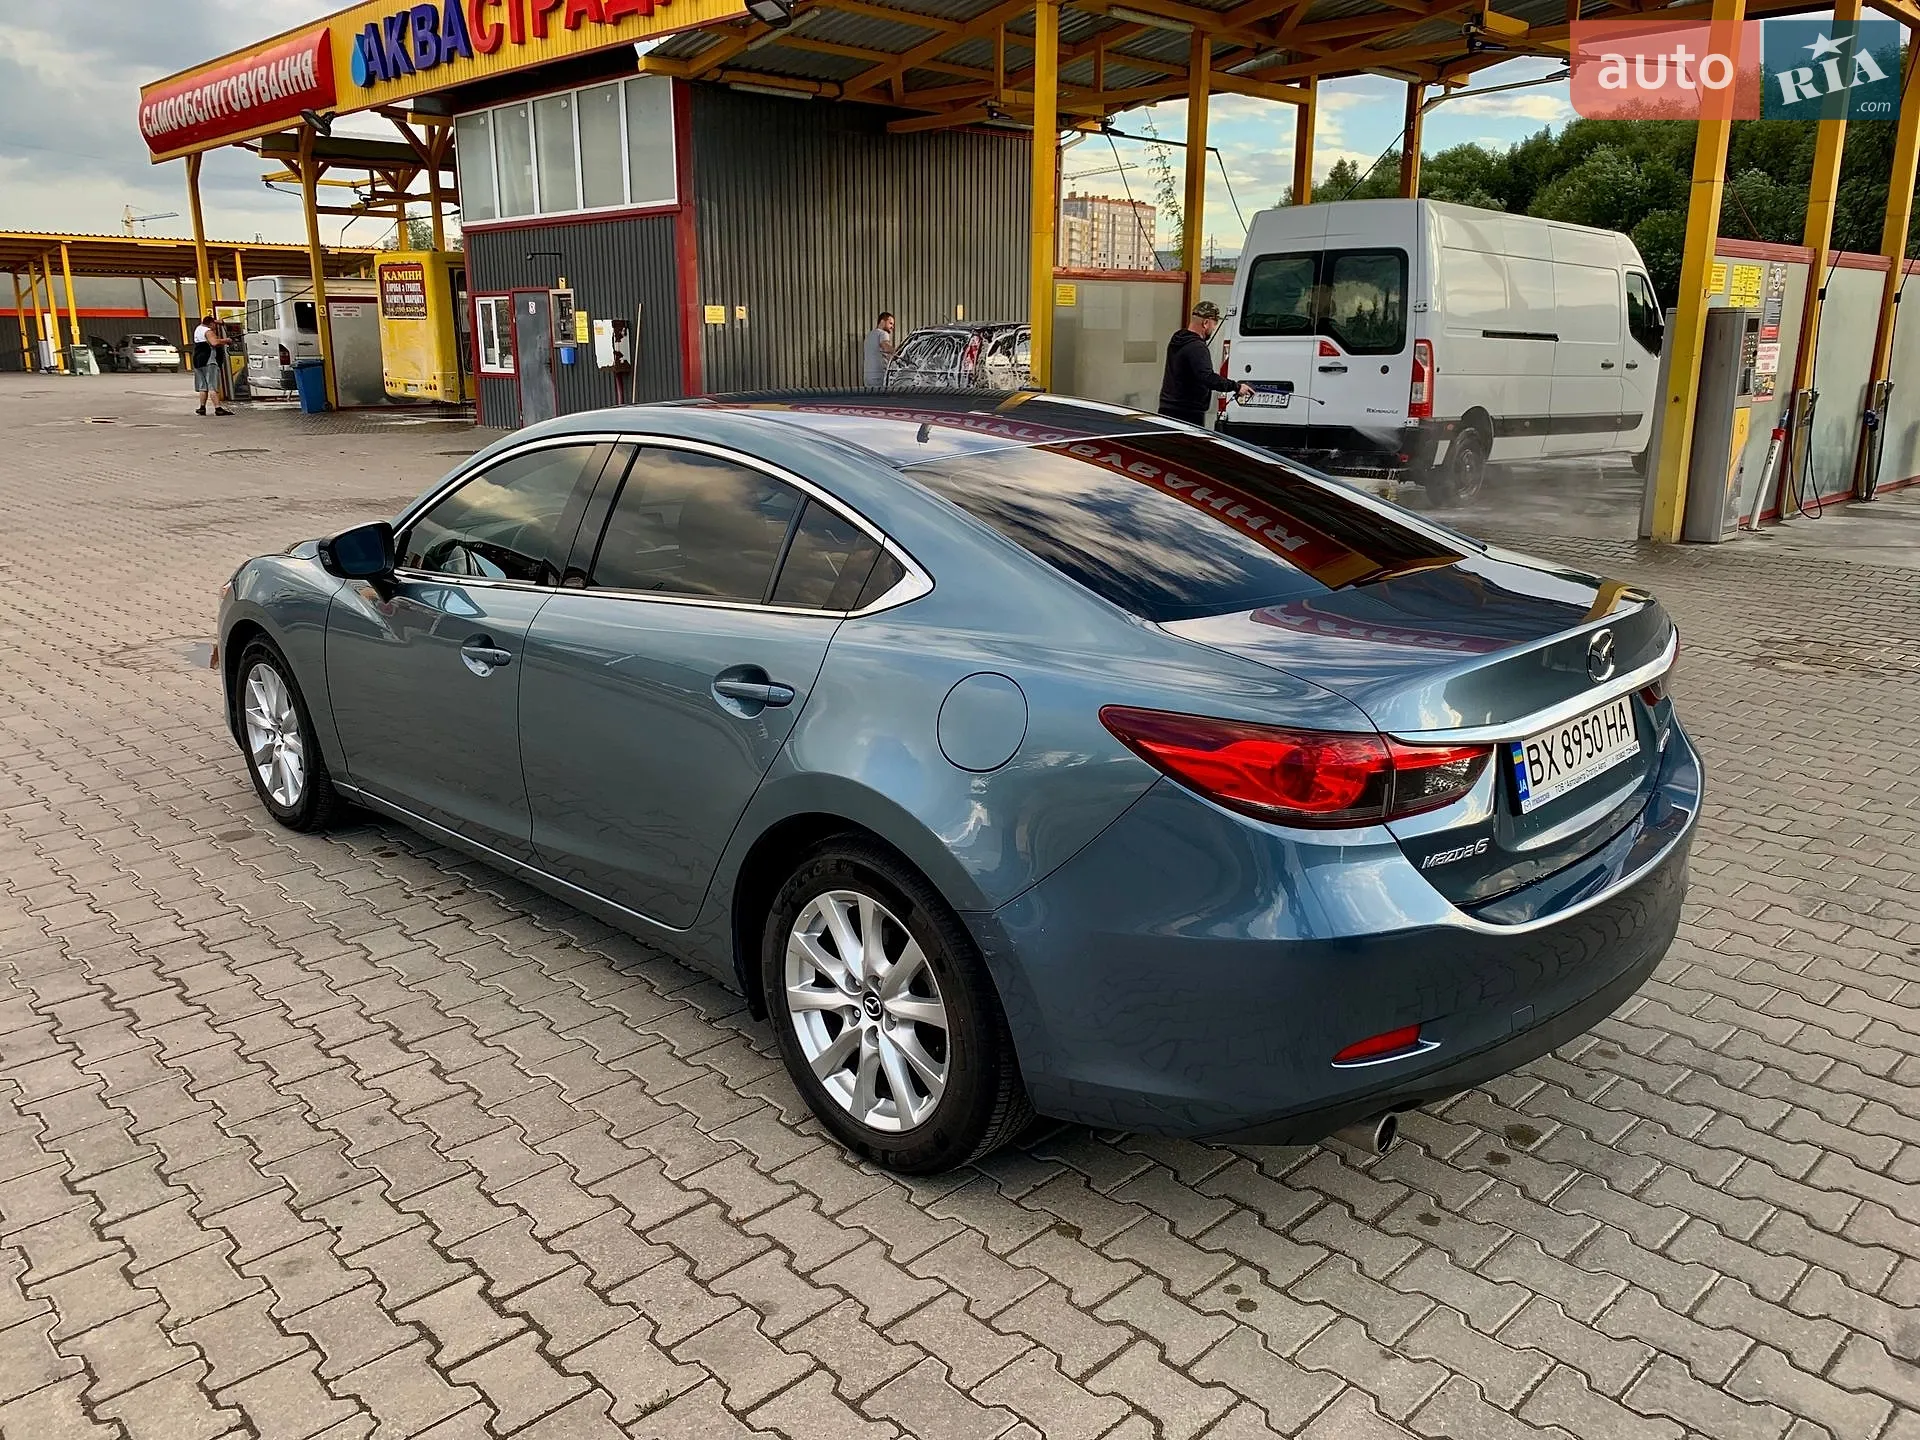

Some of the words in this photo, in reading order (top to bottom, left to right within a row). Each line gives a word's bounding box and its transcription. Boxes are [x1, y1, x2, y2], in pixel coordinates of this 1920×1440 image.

[142, 48, 318, 138] САМООБСЛУГОВУВАННЯ
[1527, 735, 1561, 787] BX
[1561, 714, 1604, 770] 8950
[1603, 701, 1630, 748] HA
